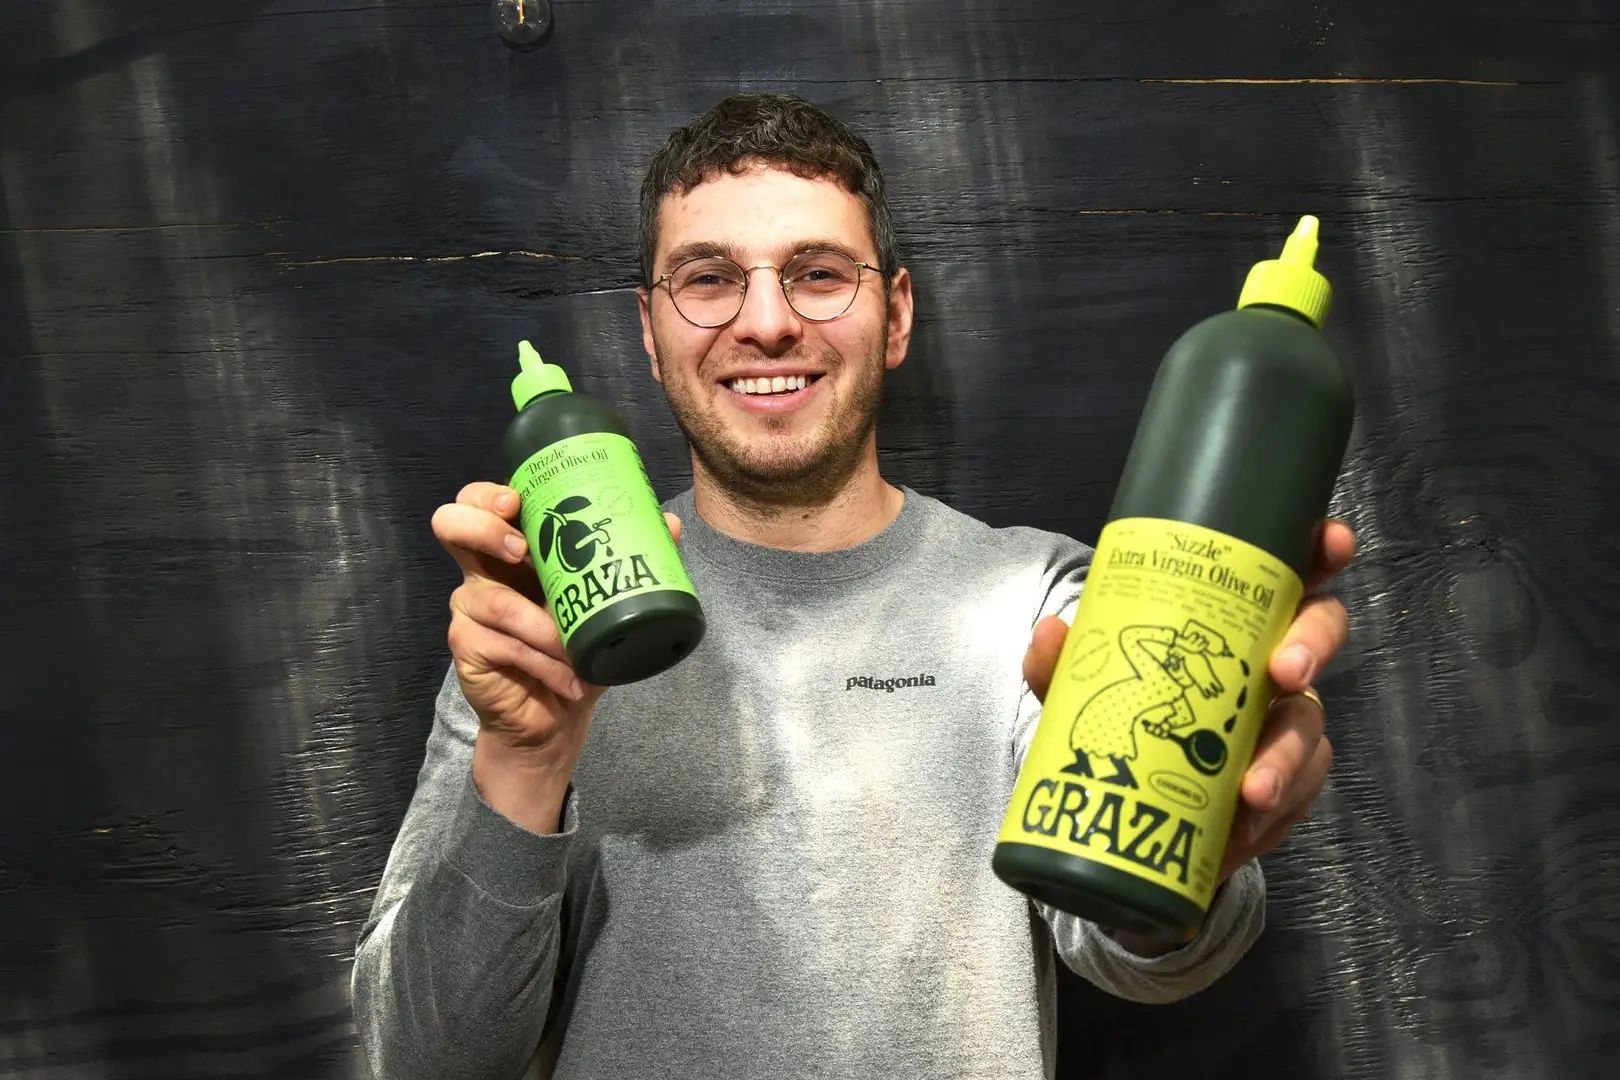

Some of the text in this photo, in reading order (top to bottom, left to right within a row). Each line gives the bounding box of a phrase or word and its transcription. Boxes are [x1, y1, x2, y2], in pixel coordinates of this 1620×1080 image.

[528, 465, 562, 489] Virgin
[560, 455, 589, 470] Olive
[591, 448, 609, 460] Oil
[555, 554, 661, 634] GRAZA
[1108, 548, 1147, 567] Extra
[1151, 549, 1204, 577] Virgin
[1208, 563, 1251, 596] Olive
[1252, 583, 1276, 609] Oil
[846, 673, 936, 693] patagonia
[1023, 778, 1198, 885] GRAZA
